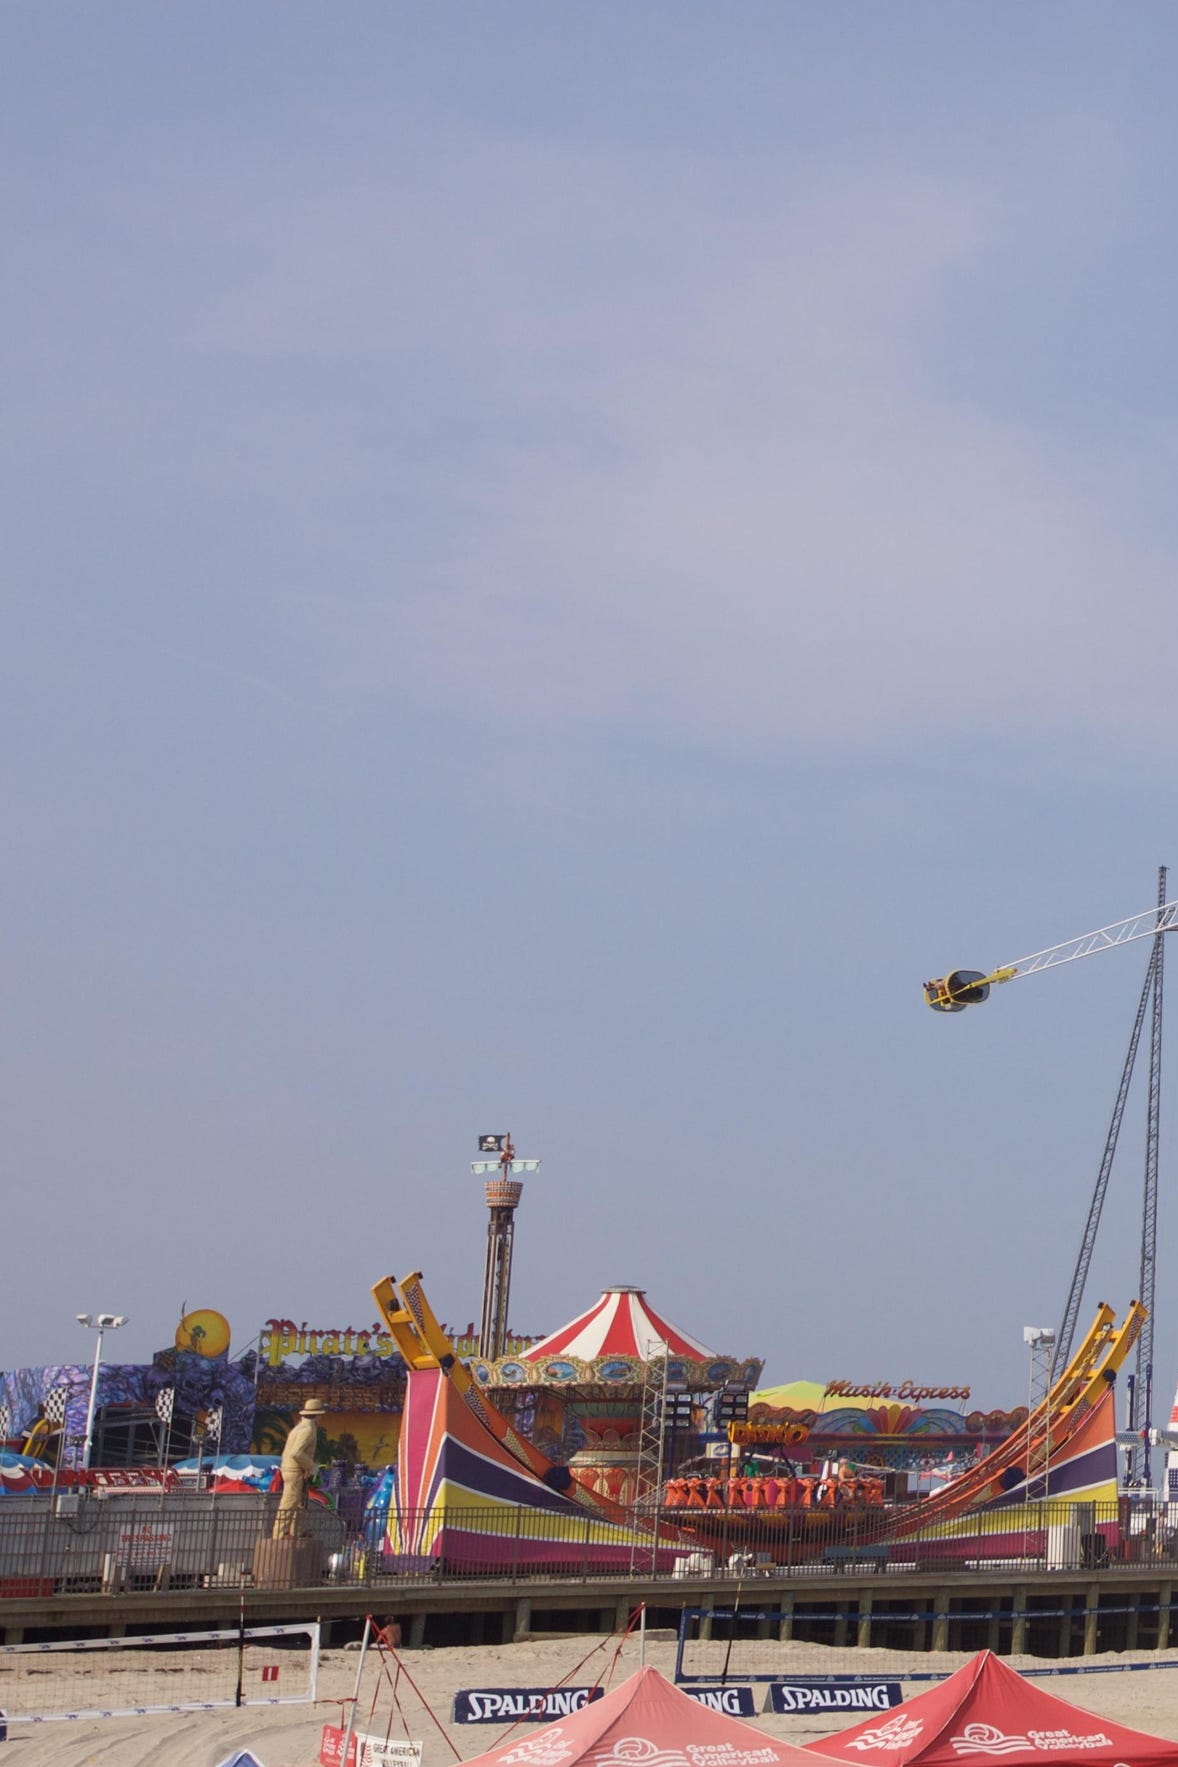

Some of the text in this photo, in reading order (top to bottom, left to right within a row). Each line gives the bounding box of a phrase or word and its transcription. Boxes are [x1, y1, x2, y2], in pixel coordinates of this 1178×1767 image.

[261, 1318, 394, 1368] Pirate's
[467, 1689, 590, 1721] SPALDING
[782, 1685, 890, 1711] SPALDING
[1027, 1729, 1071, 1739] Great
[686, 1742, 735, 1753] Great
[692, 1747, 773, 1762] American
[693, 1754, 781, 1767] Volleyball
